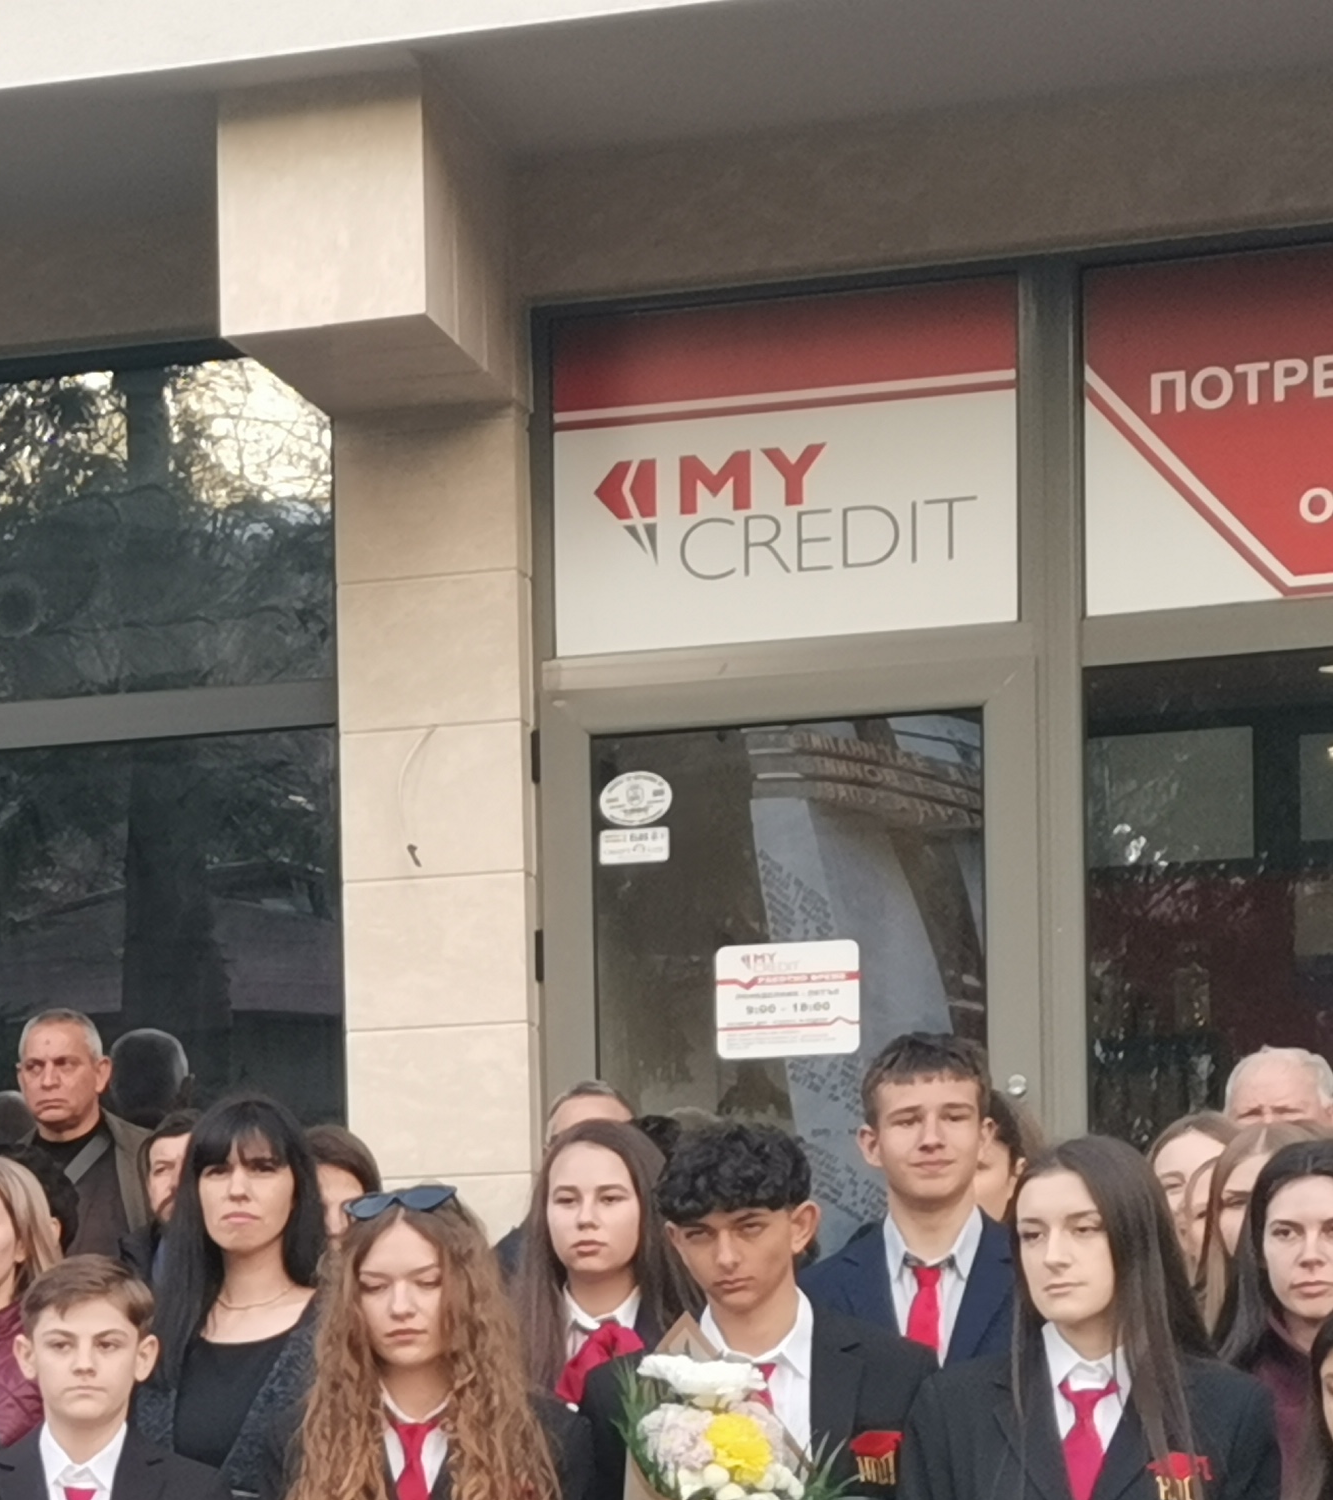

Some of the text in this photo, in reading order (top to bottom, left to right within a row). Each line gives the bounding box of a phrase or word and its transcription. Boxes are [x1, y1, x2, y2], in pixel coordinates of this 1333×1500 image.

[1150, 354, 1333, 415] ПОТРЕ
[679, 442, 827, 515] MY
[680, 495, 978, 580] CREDIT
[753, 952, 776, 965] MY
